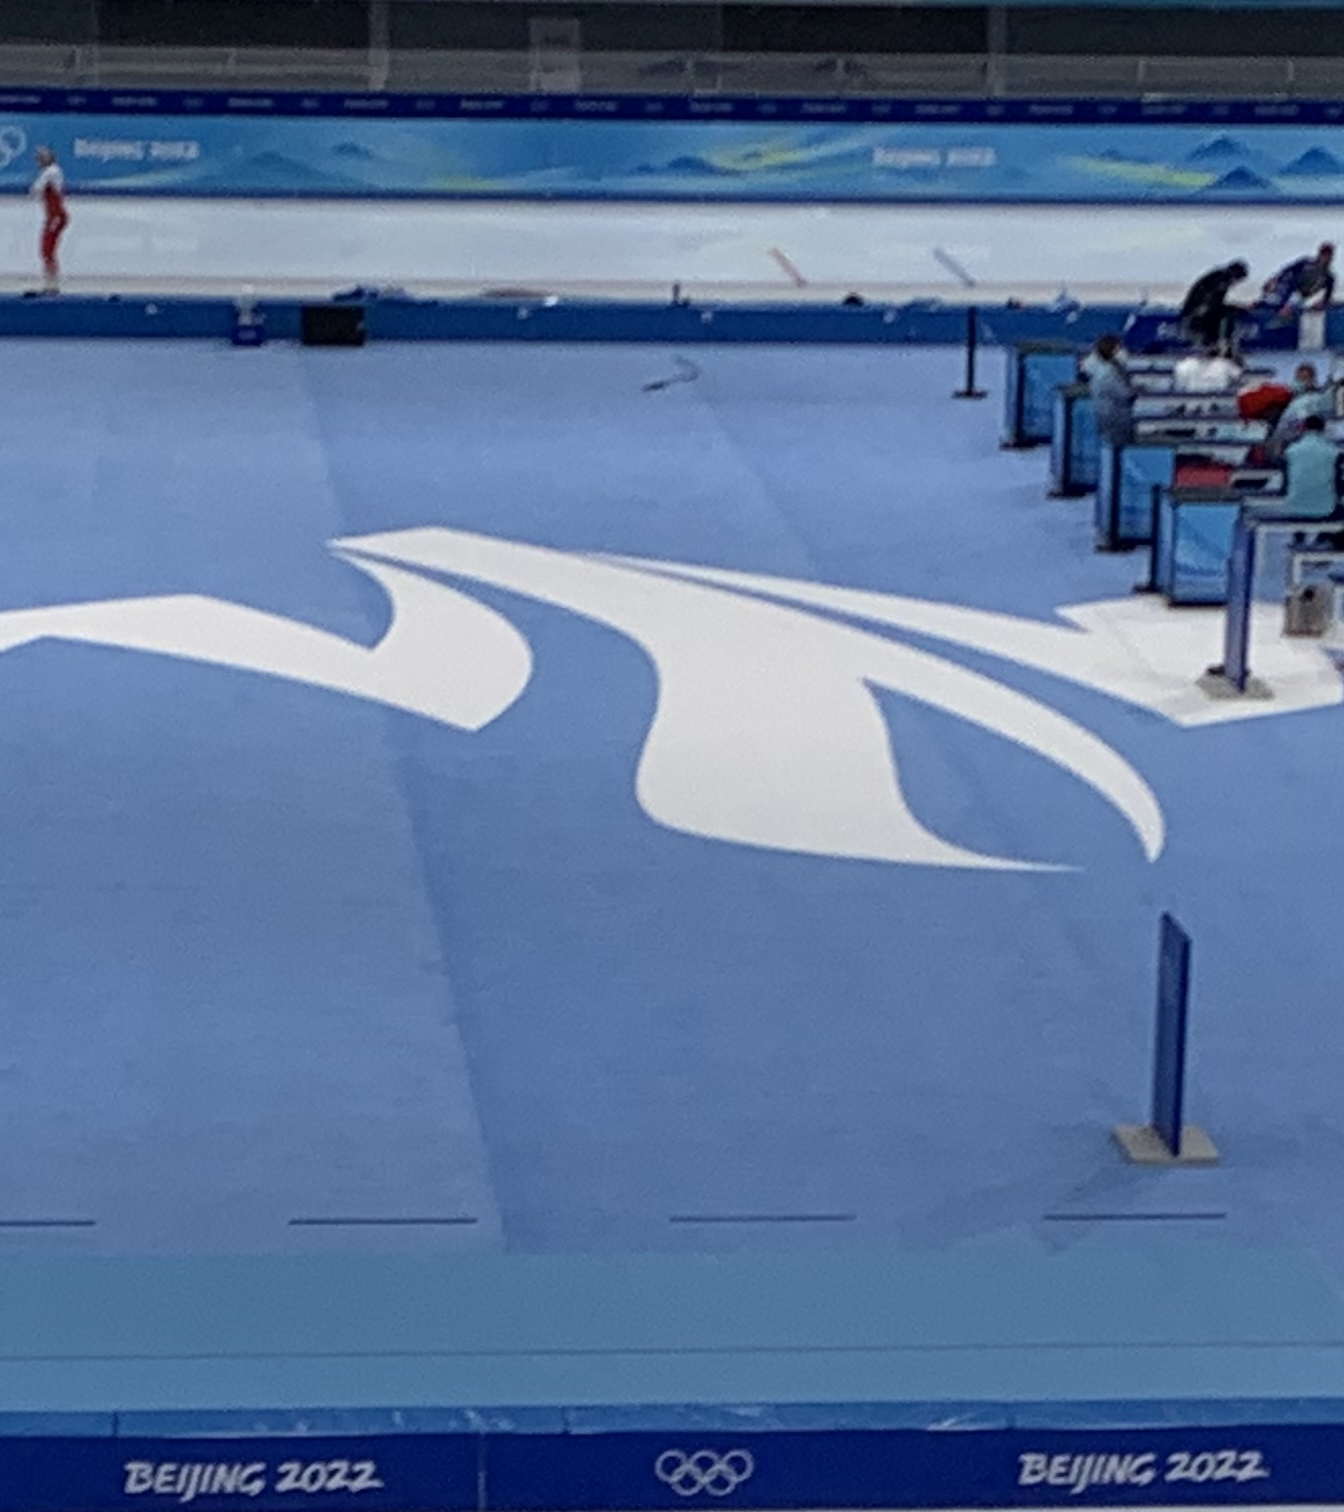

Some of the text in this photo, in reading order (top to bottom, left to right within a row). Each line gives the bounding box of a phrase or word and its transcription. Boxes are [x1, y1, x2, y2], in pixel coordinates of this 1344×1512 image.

[123, 1460, 385, 1504] BEIJING 2022
[1018, 1450, 1271, 1495] BEIJING 2022
